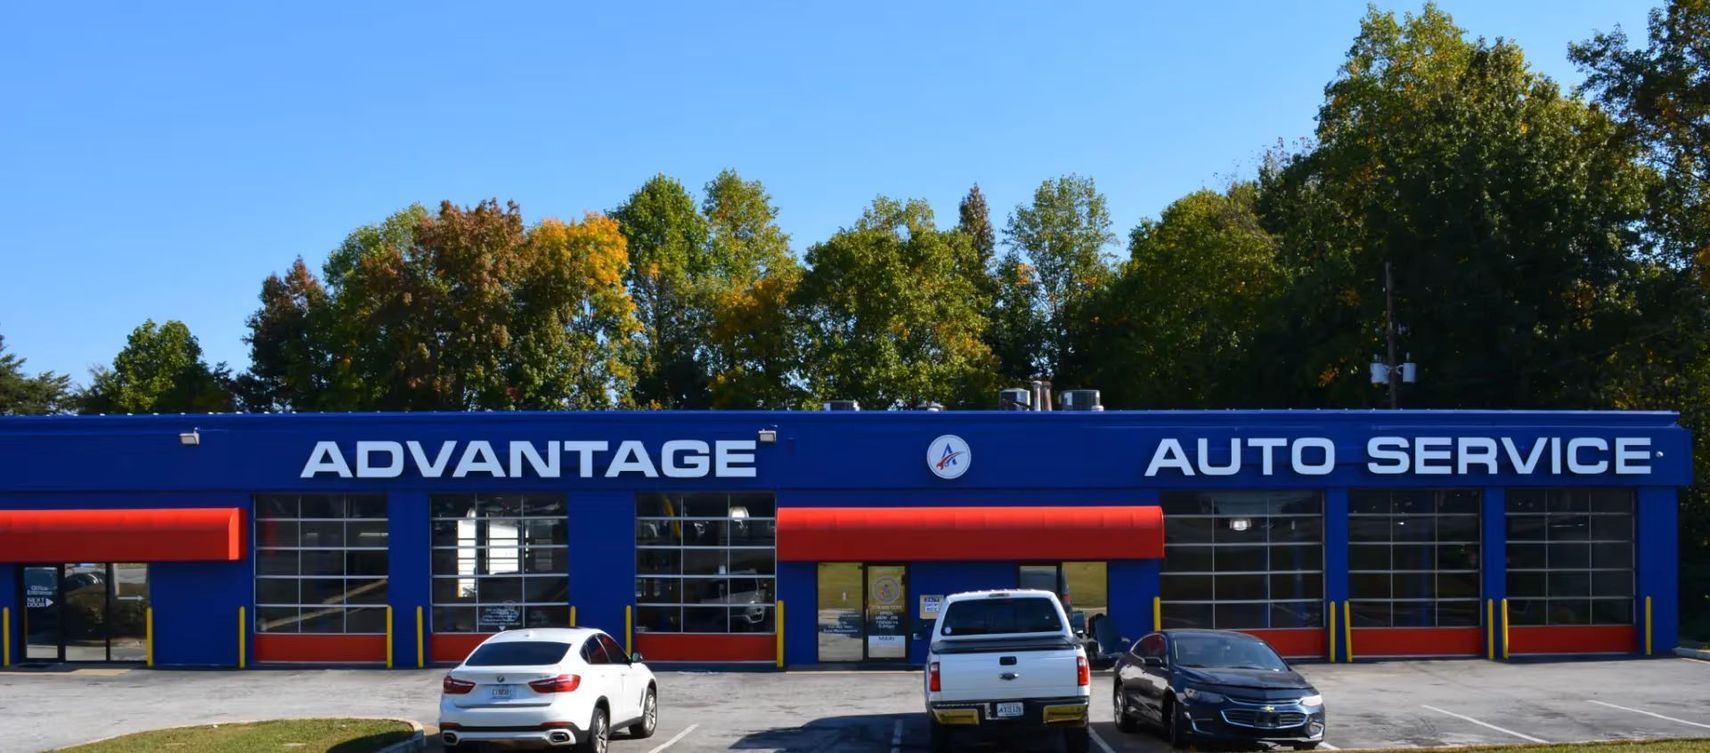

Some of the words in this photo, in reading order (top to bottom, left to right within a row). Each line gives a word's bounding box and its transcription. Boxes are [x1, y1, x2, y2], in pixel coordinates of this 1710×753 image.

[301, 440, 757, 478] ADVANTAGE
[1145, 437, 1335, 476] AUTO
[1367, 436, 1652, 474] SERVICE
